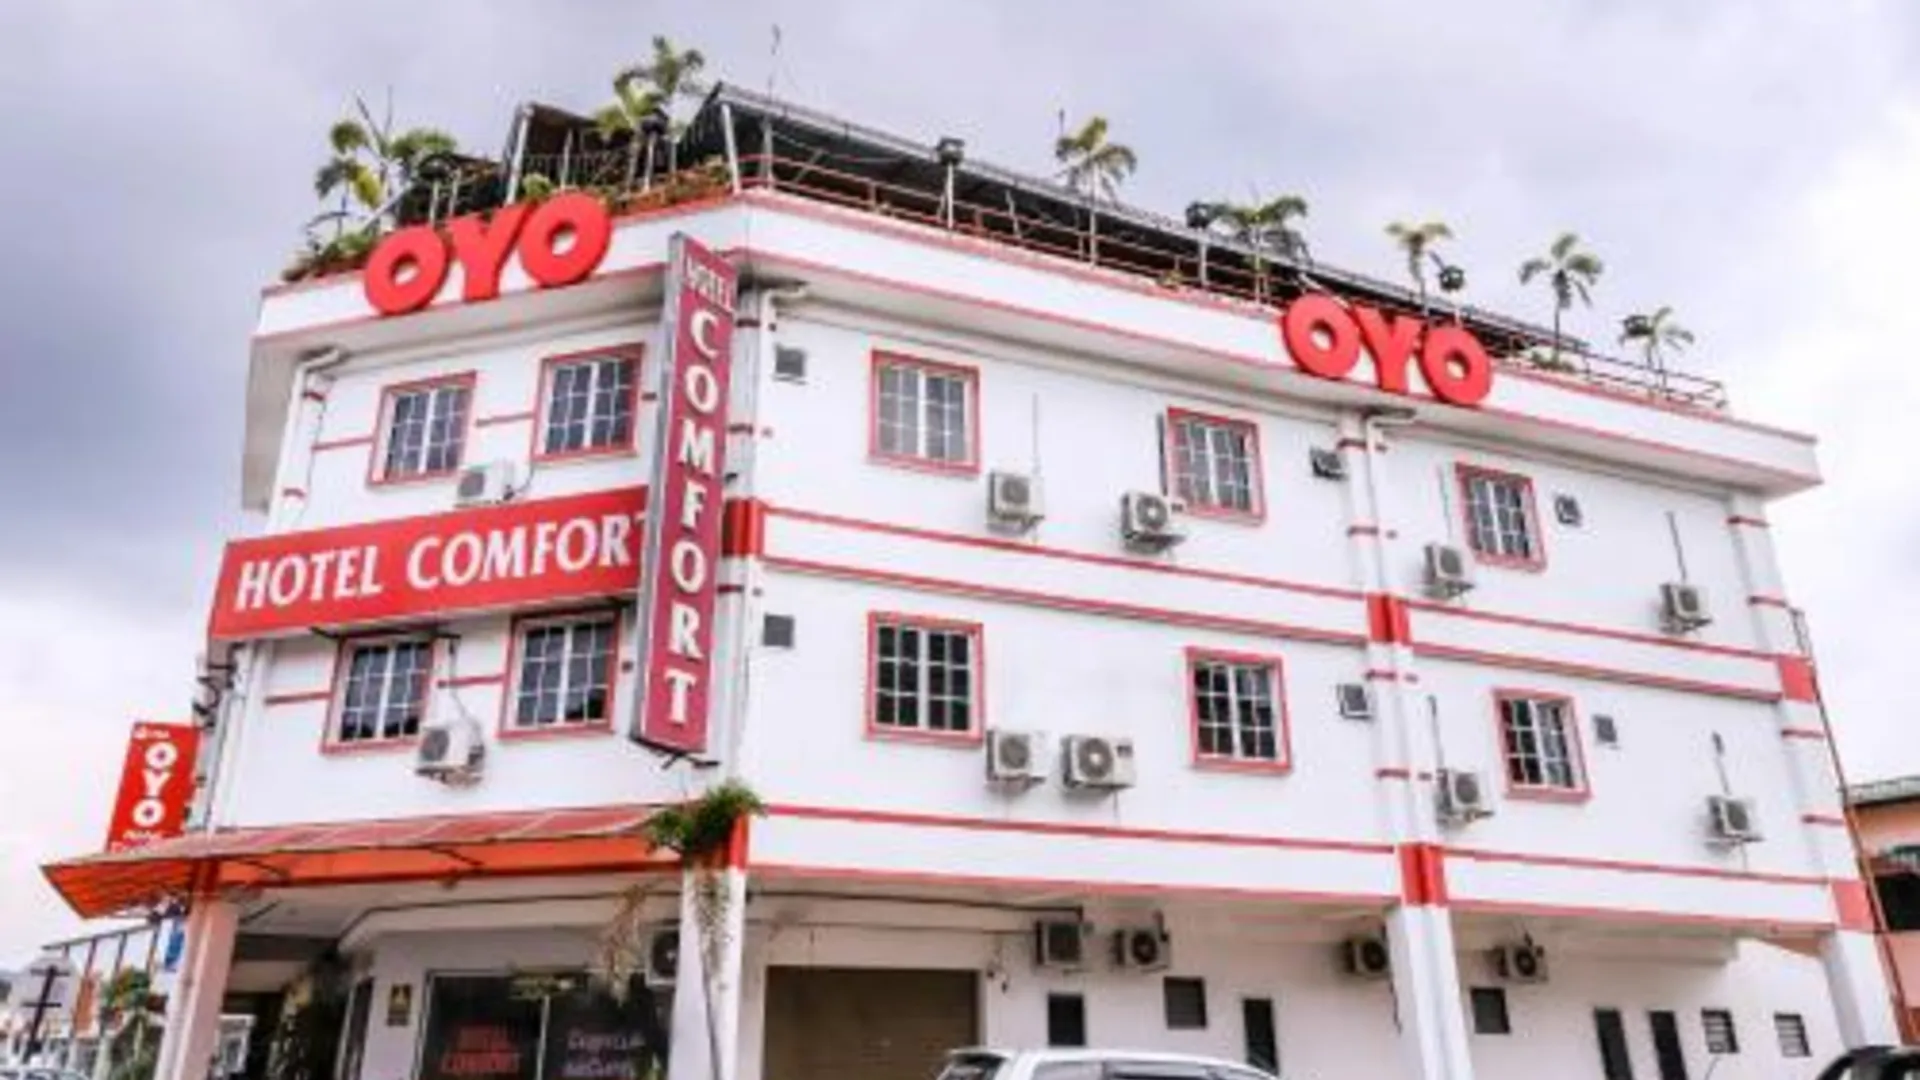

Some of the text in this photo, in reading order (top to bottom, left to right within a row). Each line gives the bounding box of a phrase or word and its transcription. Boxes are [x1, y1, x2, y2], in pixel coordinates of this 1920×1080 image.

[364, 190, 613, 316] OYO
[686, 254, 732, 311] HOTEL
[1282, 290, 1494, 404] OYO
[234, 511, 646, 611] HOTEL COMFOR
[664, 309, 722, 726] COMFORT
[132, 741, 178, 828] OYO
